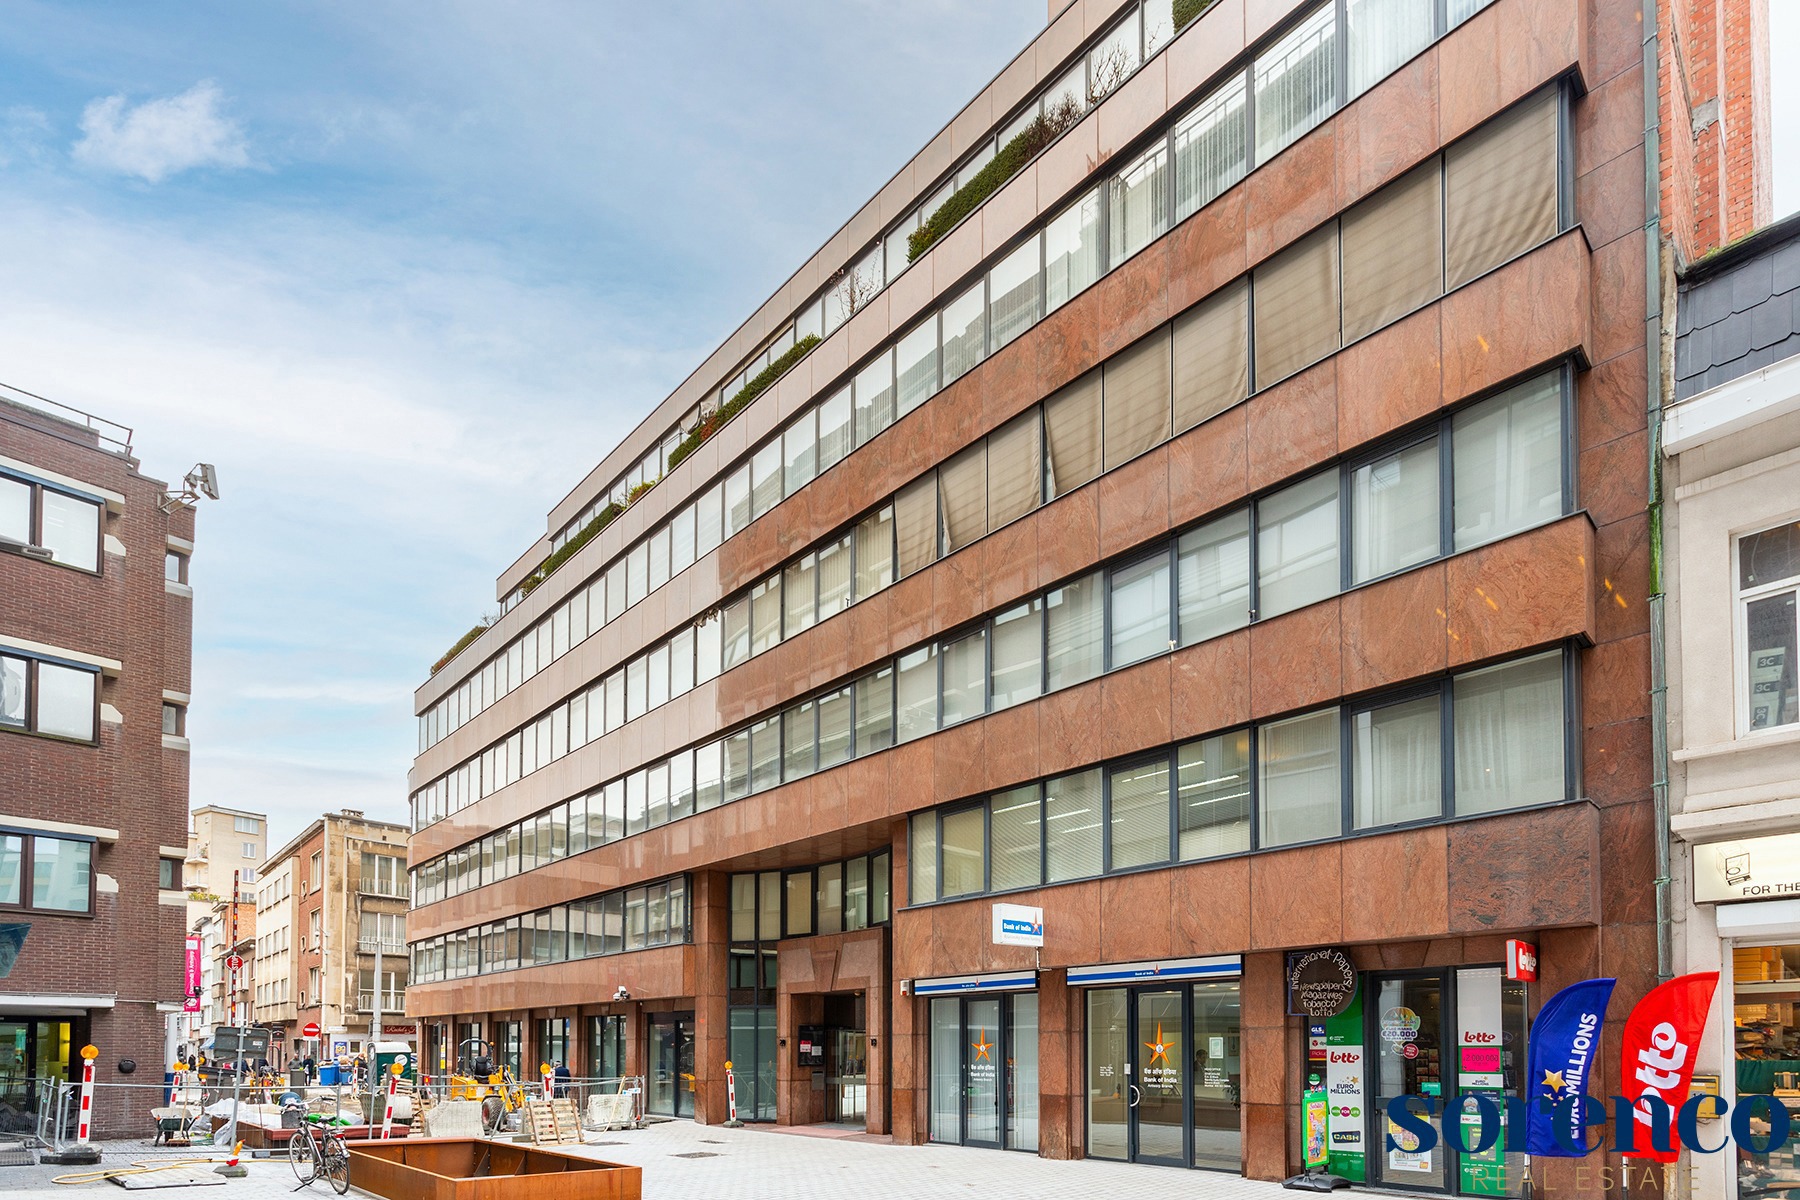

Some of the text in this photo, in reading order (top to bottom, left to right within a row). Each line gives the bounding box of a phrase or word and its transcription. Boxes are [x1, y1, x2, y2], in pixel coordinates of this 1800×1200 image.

[1760, 657, 1775, 666] 3C
[1756, 683, 1771, 692] 3C
[1742, 885, 1771, 896] FOR
[1003, 922, 1015, 930] Bank
[1020, 924, 1032, 932] India
[231, 955, 239, 970] STOP
[1292, 949, 1353, 989] International Papers
[1301, 991, 1343, 1001] Magazines
[1303, 999, 1338, 1008] Tobacco
